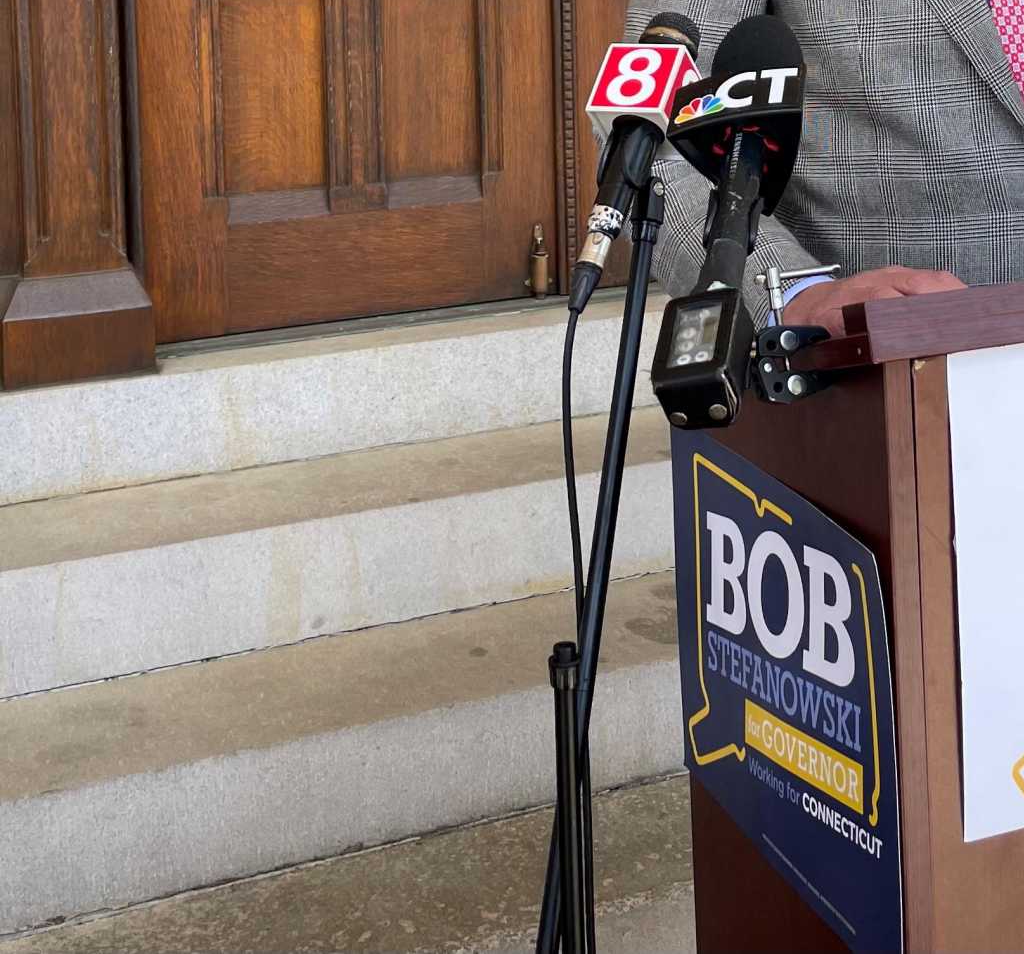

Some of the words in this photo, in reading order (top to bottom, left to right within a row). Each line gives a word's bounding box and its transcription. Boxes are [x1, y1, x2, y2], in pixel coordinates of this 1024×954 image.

[605, 48, 662, 106] 8
[715, 67, 798, 108] CT
[706, 511, 856, 688] BOB
[707, 630, 862, 753] STEFANOWSKI
[747, 713, 761, 737] for
[762, 719, 860, 803] GOVERNOR
[748, 757, 784, 799] Working
[786, 782, 801, 806] for
[802, 792, 883, 859] CONNECTICUT
